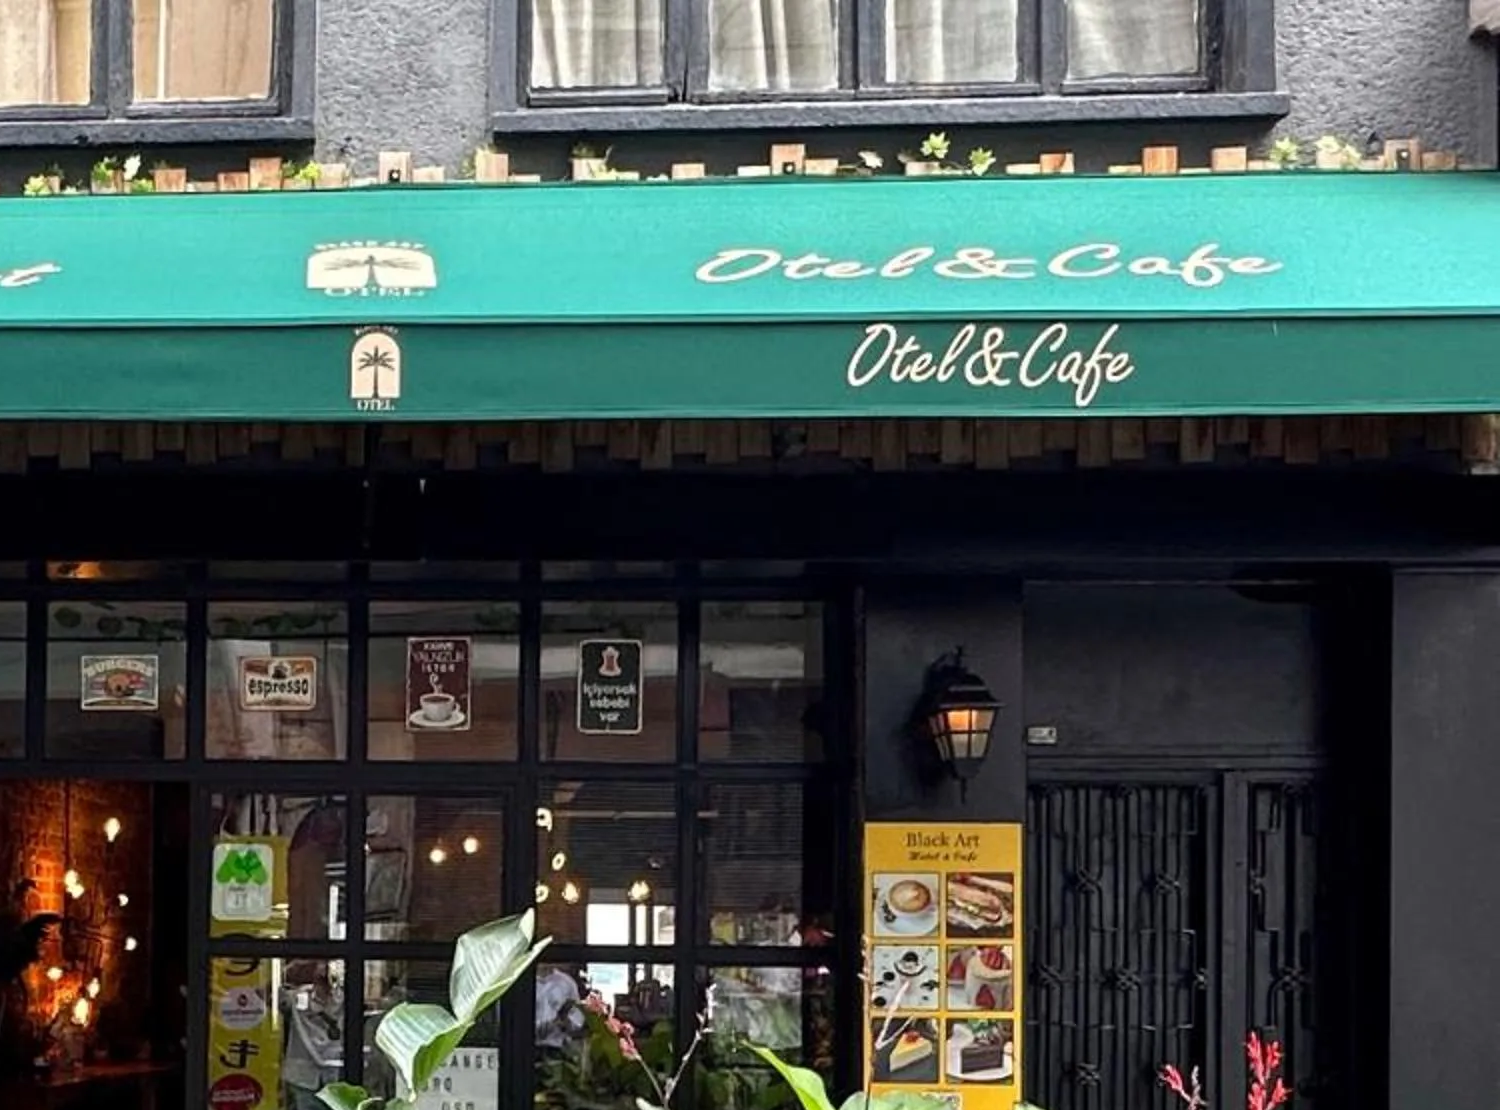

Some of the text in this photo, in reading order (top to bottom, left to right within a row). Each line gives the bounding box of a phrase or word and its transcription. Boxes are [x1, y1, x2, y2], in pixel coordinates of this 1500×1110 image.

[846, 322, 1135, 407] Otel&Cafe
[905, 831, 980, 848] Black Art
